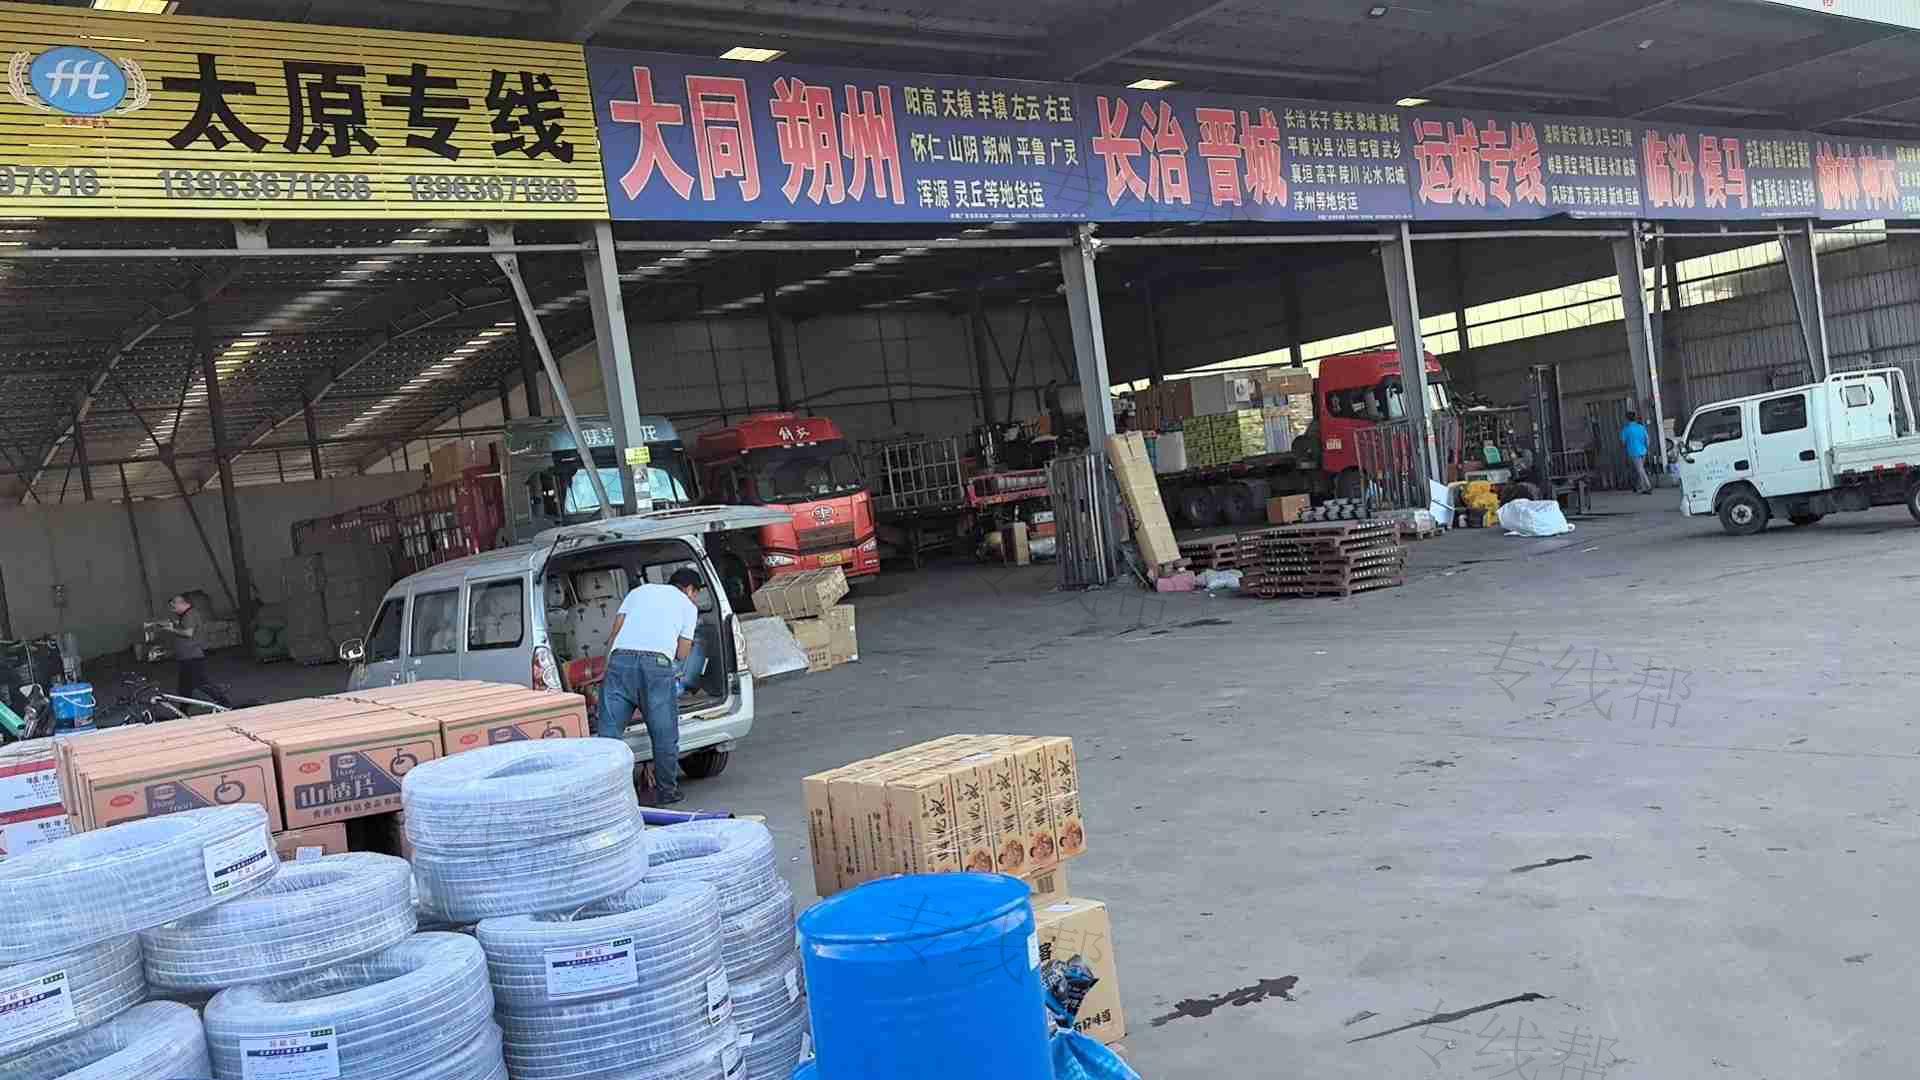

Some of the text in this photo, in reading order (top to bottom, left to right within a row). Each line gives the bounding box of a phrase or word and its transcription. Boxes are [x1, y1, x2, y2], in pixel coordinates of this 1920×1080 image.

[162, 53, 576, 164] 太原专线
[904, 86, 1074, 123] 阳高 天镇 丰镇 左云 右玉
[610, 66, 905, 205] 大同 朔州
[911, 132, 1080, 167] 怀仁 山阴 朔州 平鲁 广灵
[1092, 95, 1288, 207] 长治 晋城
[1413, 117, 1546, 208] 运城专线
[1641, 128, 1697, 209] 临汾
[1699, 132, 1749, 209] 侯马
[158, 169, 373, 200] 13963671266
[404, 174, 580, 202] 13963671366
[917, 179, 1046, 210] 浑源 灵丘等地货运
[300, 778, 375, 808] 山楂片
